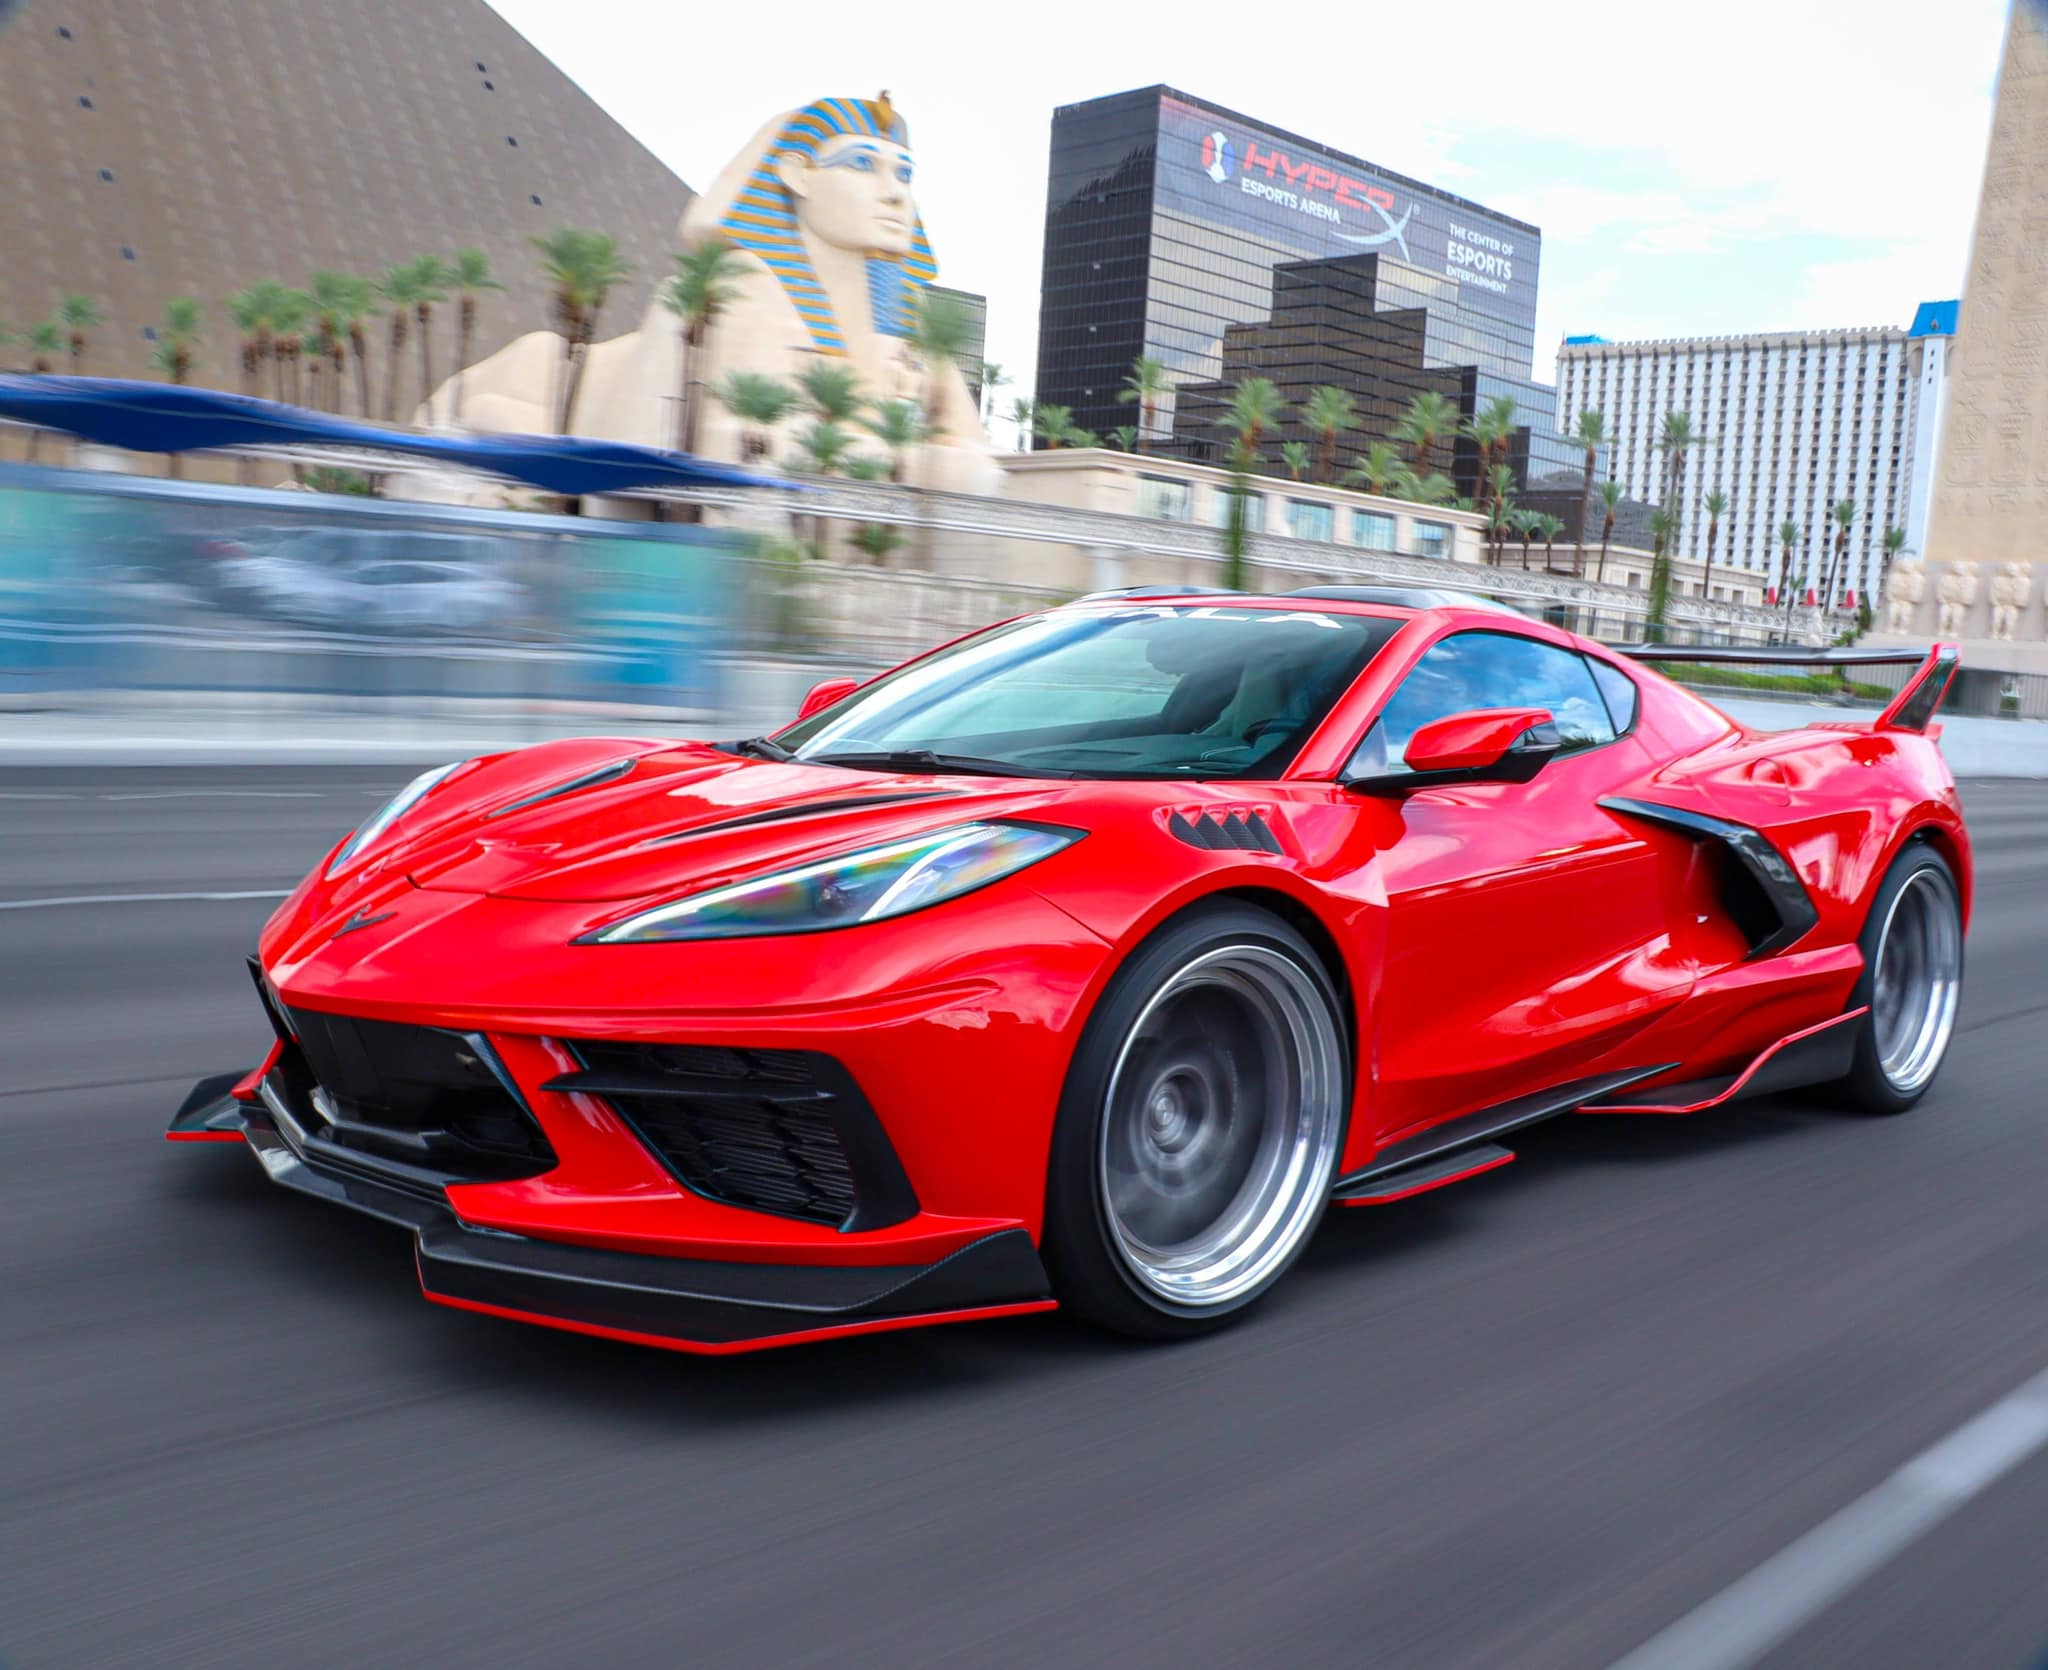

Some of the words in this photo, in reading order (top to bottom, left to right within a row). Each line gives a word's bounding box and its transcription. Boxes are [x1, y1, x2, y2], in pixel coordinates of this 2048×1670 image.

[1241, 177, 1298, 209] ESPORTS
[1299, 198, 1341, 224] ARENA
[1450, 223, 1466, 240] THE
[1467, 231, 1500, 252] CENTER
[1501, 243, 1514, 256] OF
[1447, 240, 1512, 280] ESPORTS
